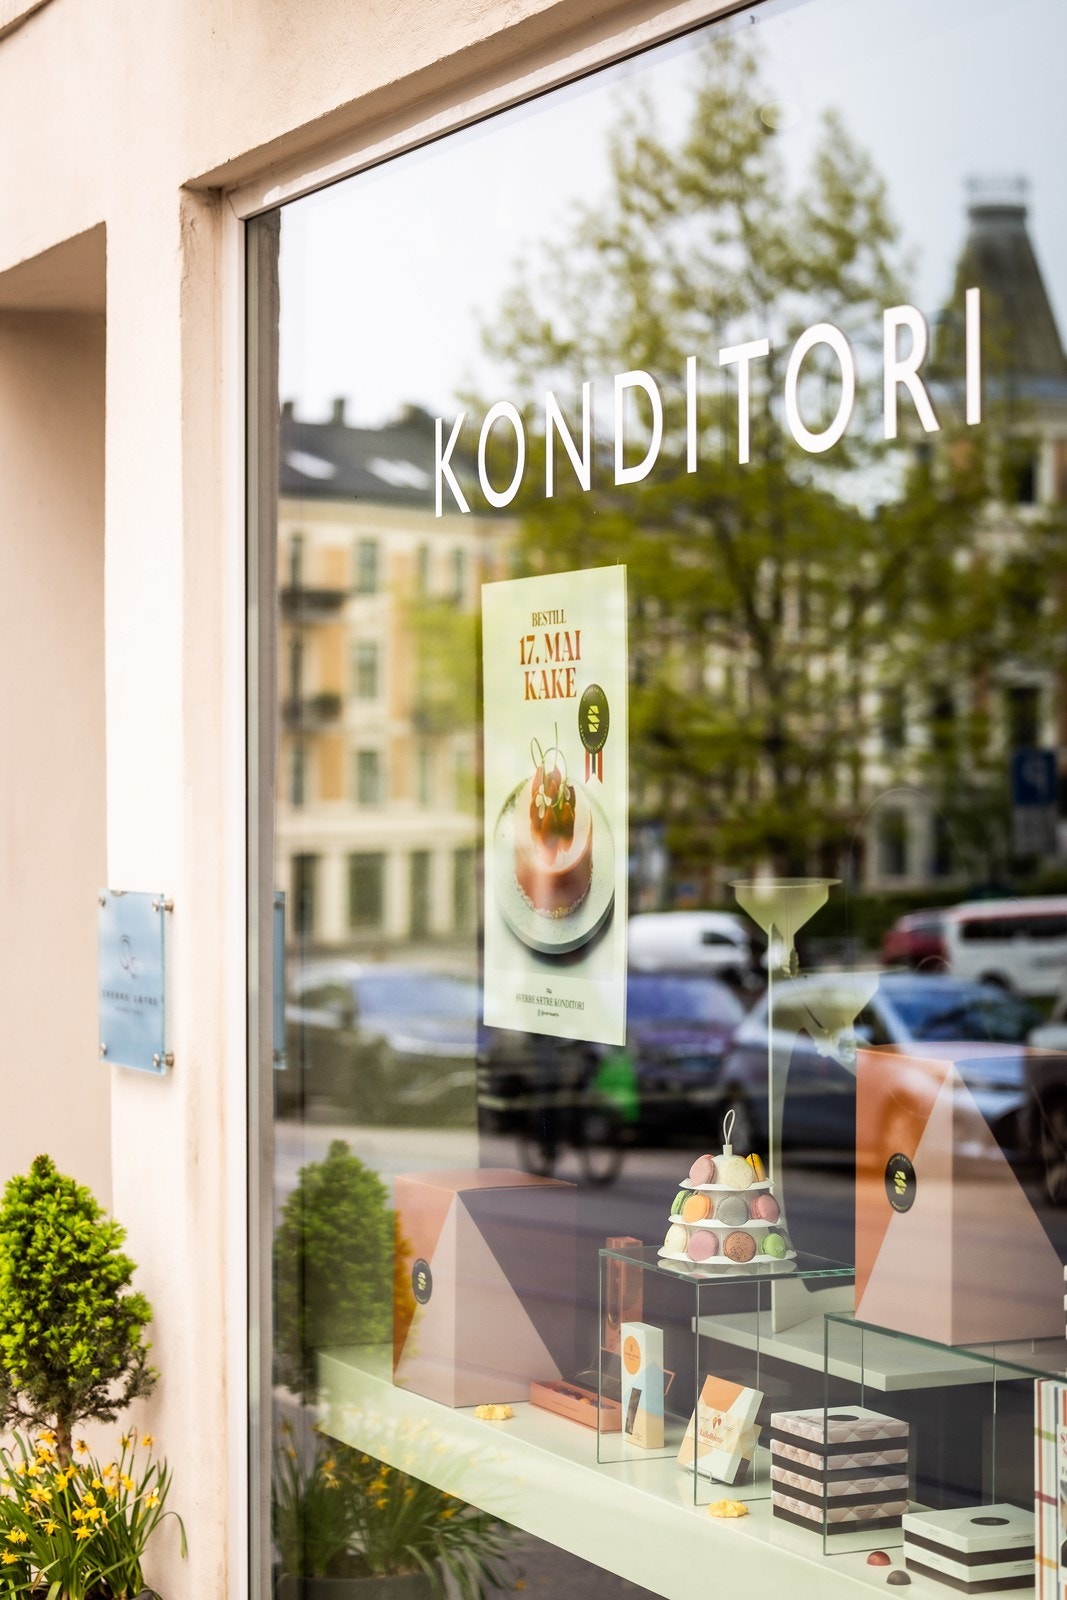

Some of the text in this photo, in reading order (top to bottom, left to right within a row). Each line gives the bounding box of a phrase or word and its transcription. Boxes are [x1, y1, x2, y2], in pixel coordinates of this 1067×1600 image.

[435, 287, 981, 517] KONDITORI
[531, 609, 567, 627] BESTILL
[519, 630, 582, 665] 17. MAI
[524, 667, 577, 701] KAKE
[554, 998, 585, 1011] KONDITORI
